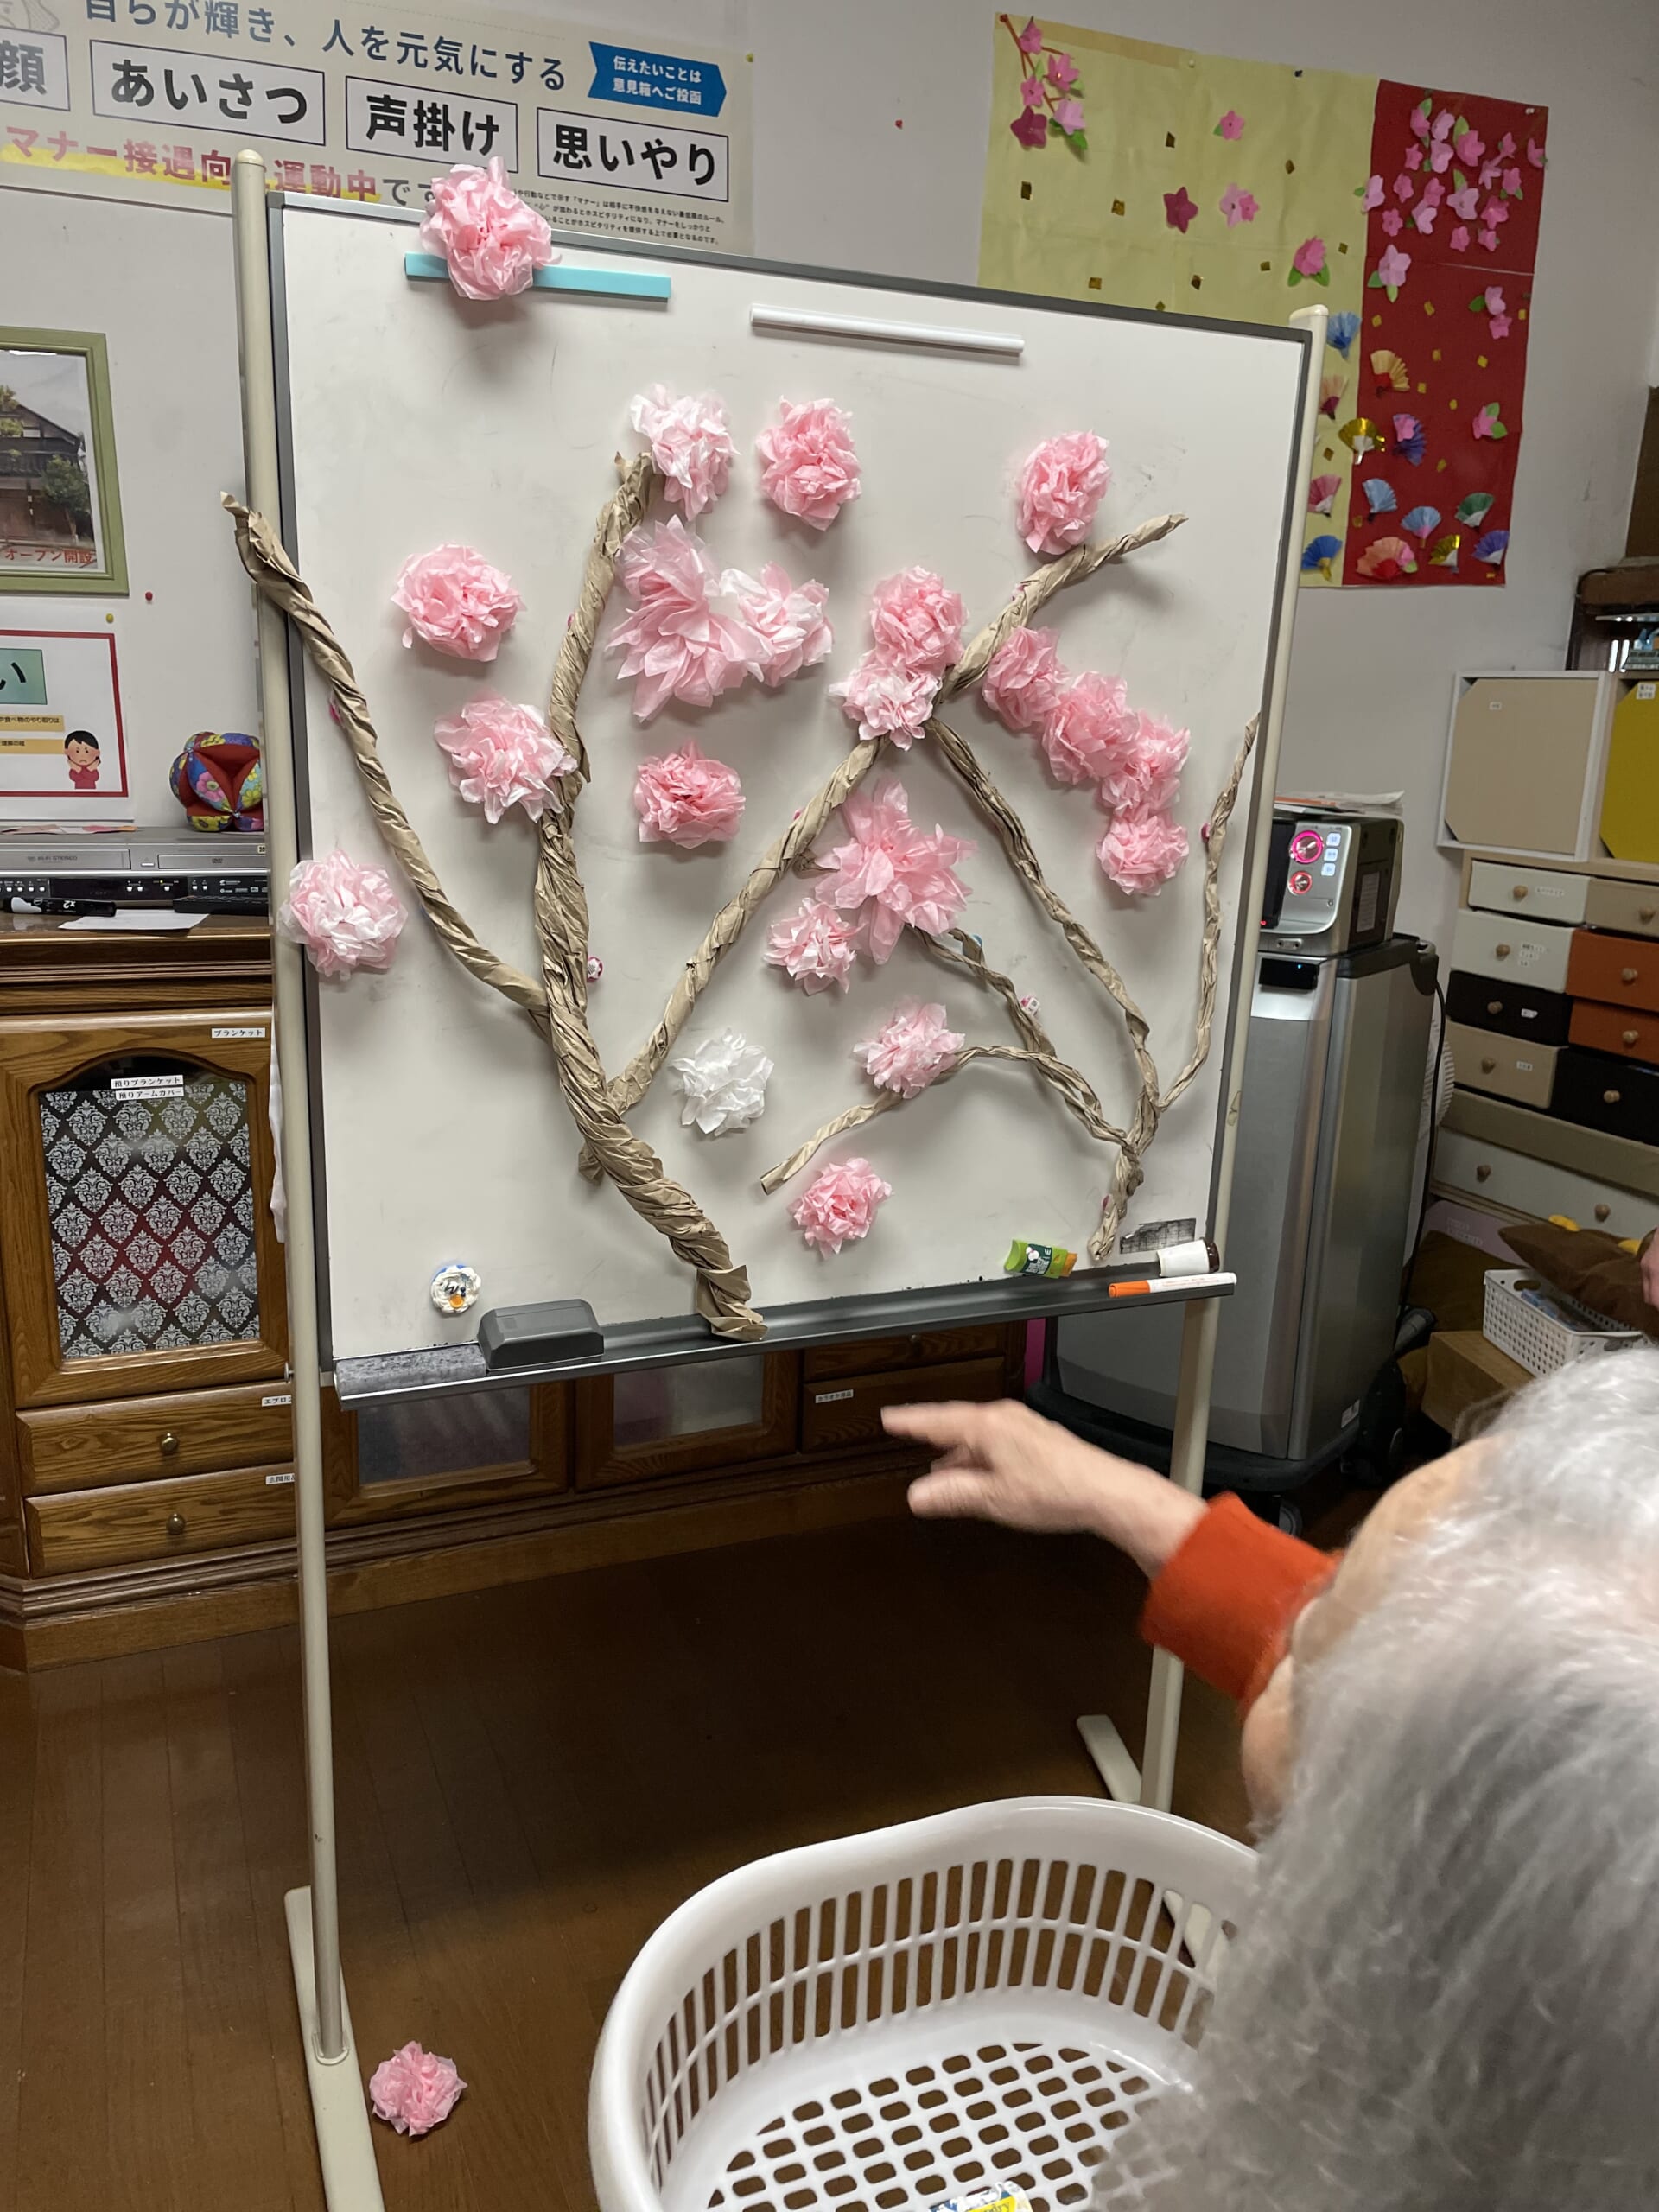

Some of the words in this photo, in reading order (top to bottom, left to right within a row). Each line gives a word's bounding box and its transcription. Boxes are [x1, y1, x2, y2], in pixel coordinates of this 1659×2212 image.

[0, 40, 47, 95] 顔
[111, 59, 308, 124] あいさつ
[613, 55, 702, 83] 伝えたいことは
[366, 94, 500, 156] 声掛け
[553, 124, 715, 186] 思いやり
[6, 126, 435, 207] マナー接遇向運動中で
[213, 1028, 263, 1037] ブランケット
